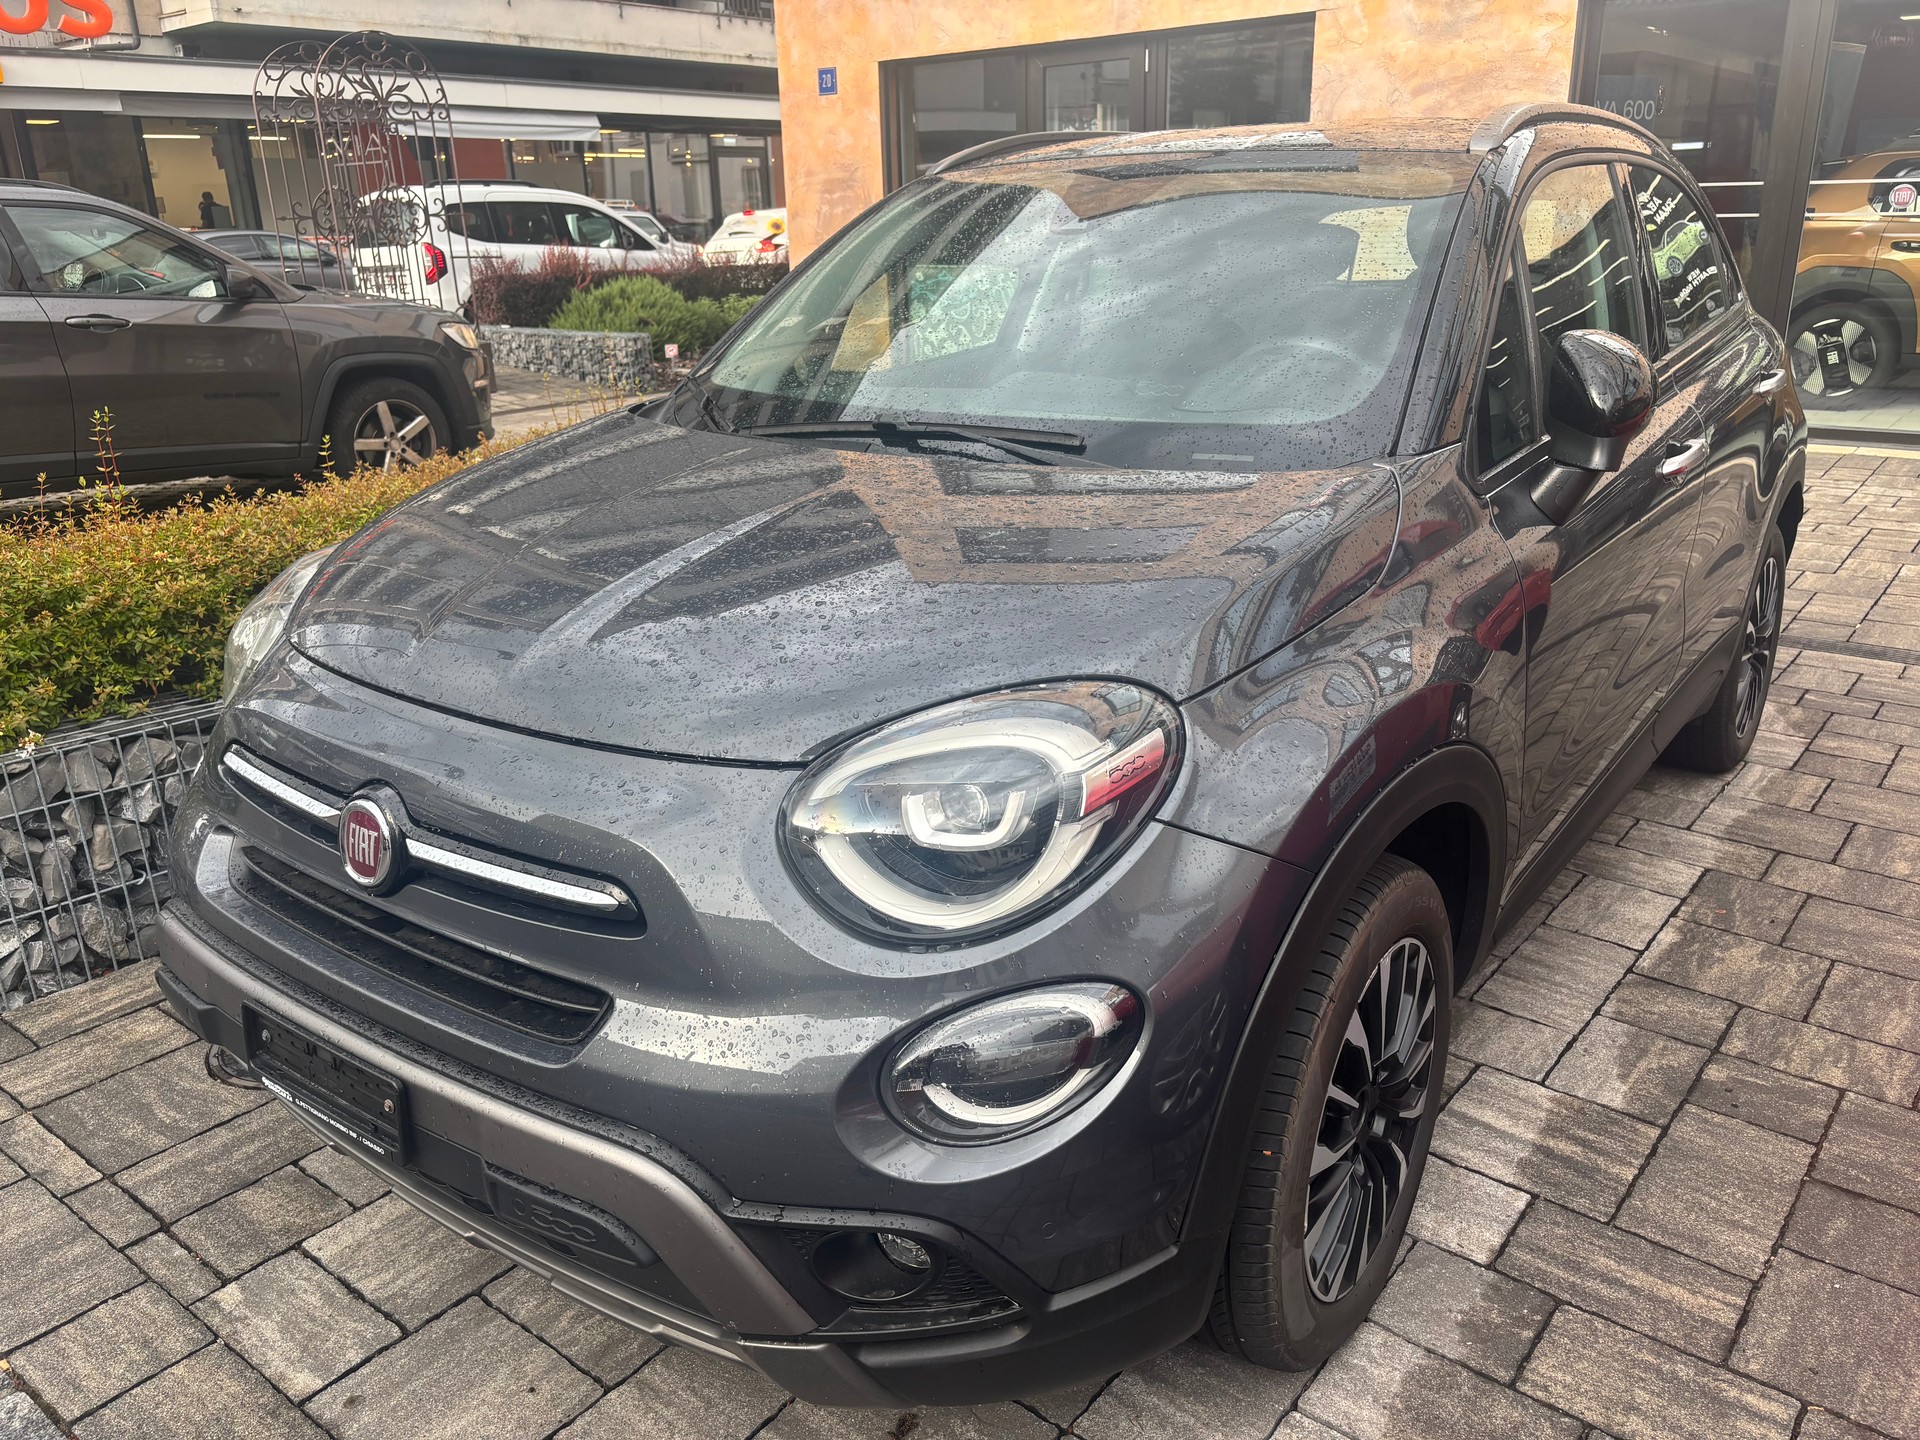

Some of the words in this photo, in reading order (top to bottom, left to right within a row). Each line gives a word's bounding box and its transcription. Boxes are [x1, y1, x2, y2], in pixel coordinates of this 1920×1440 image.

[822, 74, 831, 87] 20
[1624, 100, 1655, 120] 600
[1109, 755, 1146, 784] 500
[349, 822, 378, 867] FIAT
[530, 1204, 597, 1242] 500
